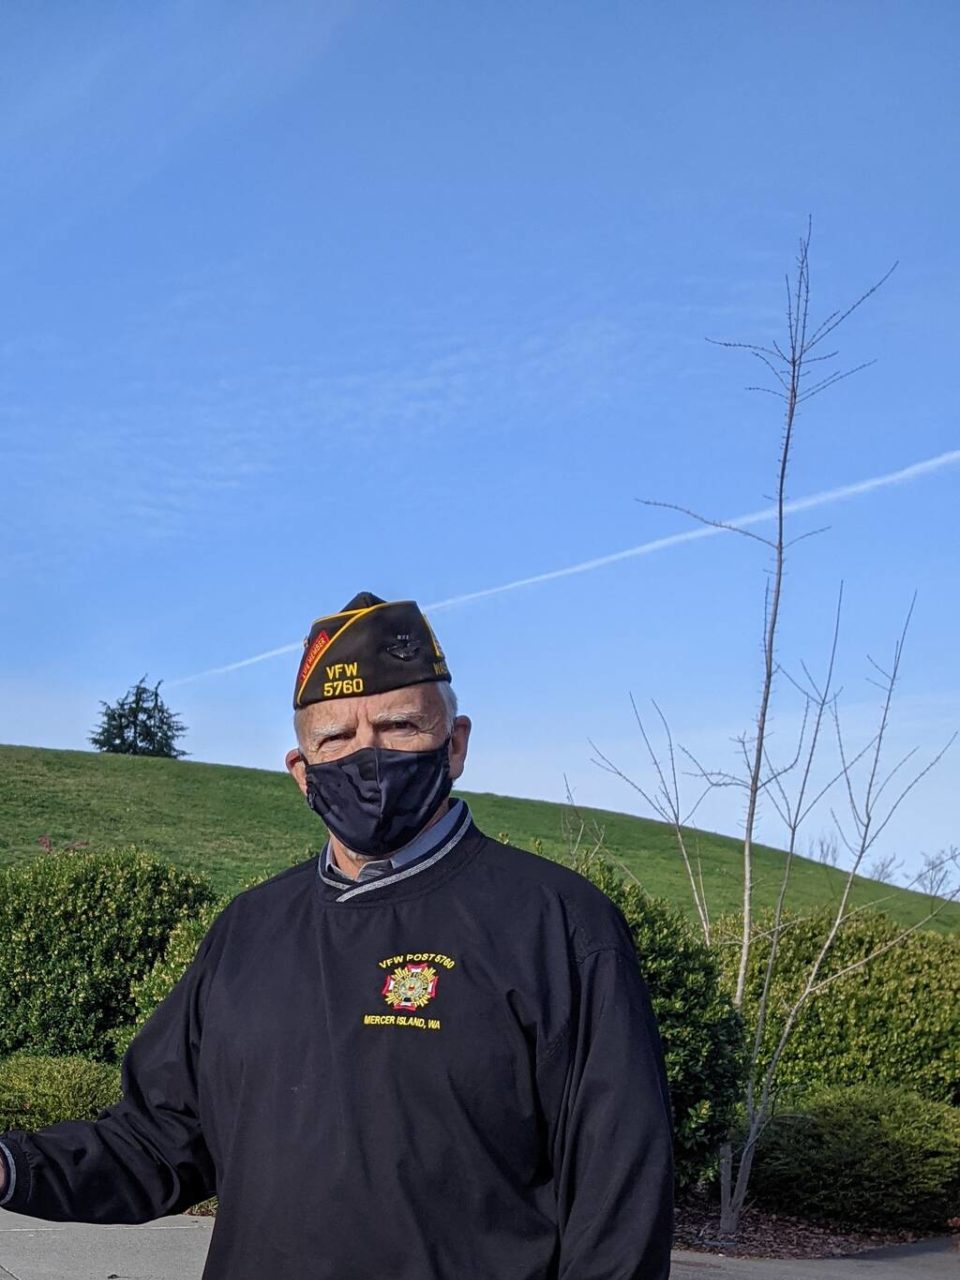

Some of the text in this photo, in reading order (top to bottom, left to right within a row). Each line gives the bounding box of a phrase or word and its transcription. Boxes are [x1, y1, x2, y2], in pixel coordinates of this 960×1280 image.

[326, 662, 358, 680] VFW
[323, 678, 364, 697] 5760
[378, 953, 455, 970] VFW POST 5760
[363, 1014, 441, 1030] MERCER ISLAND, WA
